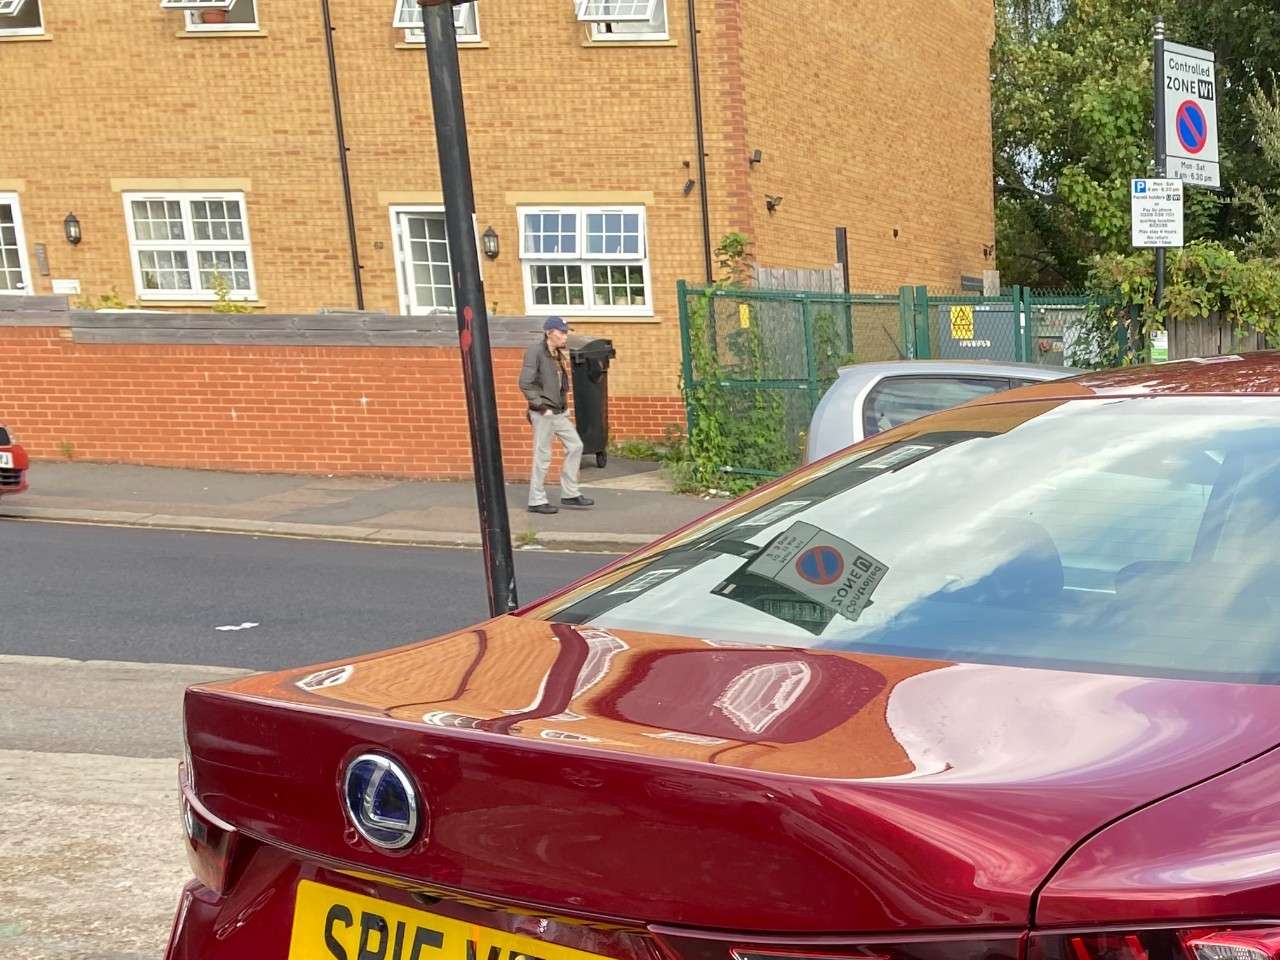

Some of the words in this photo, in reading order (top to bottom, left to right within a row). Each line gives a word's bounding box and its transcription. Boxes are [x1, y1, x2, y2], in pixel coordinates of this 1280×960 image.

[1168, 58, 1210, 77] Controlled
[1166, 76, 1196, 95] ZONE
[1198, 79, 1214, 100] W1
